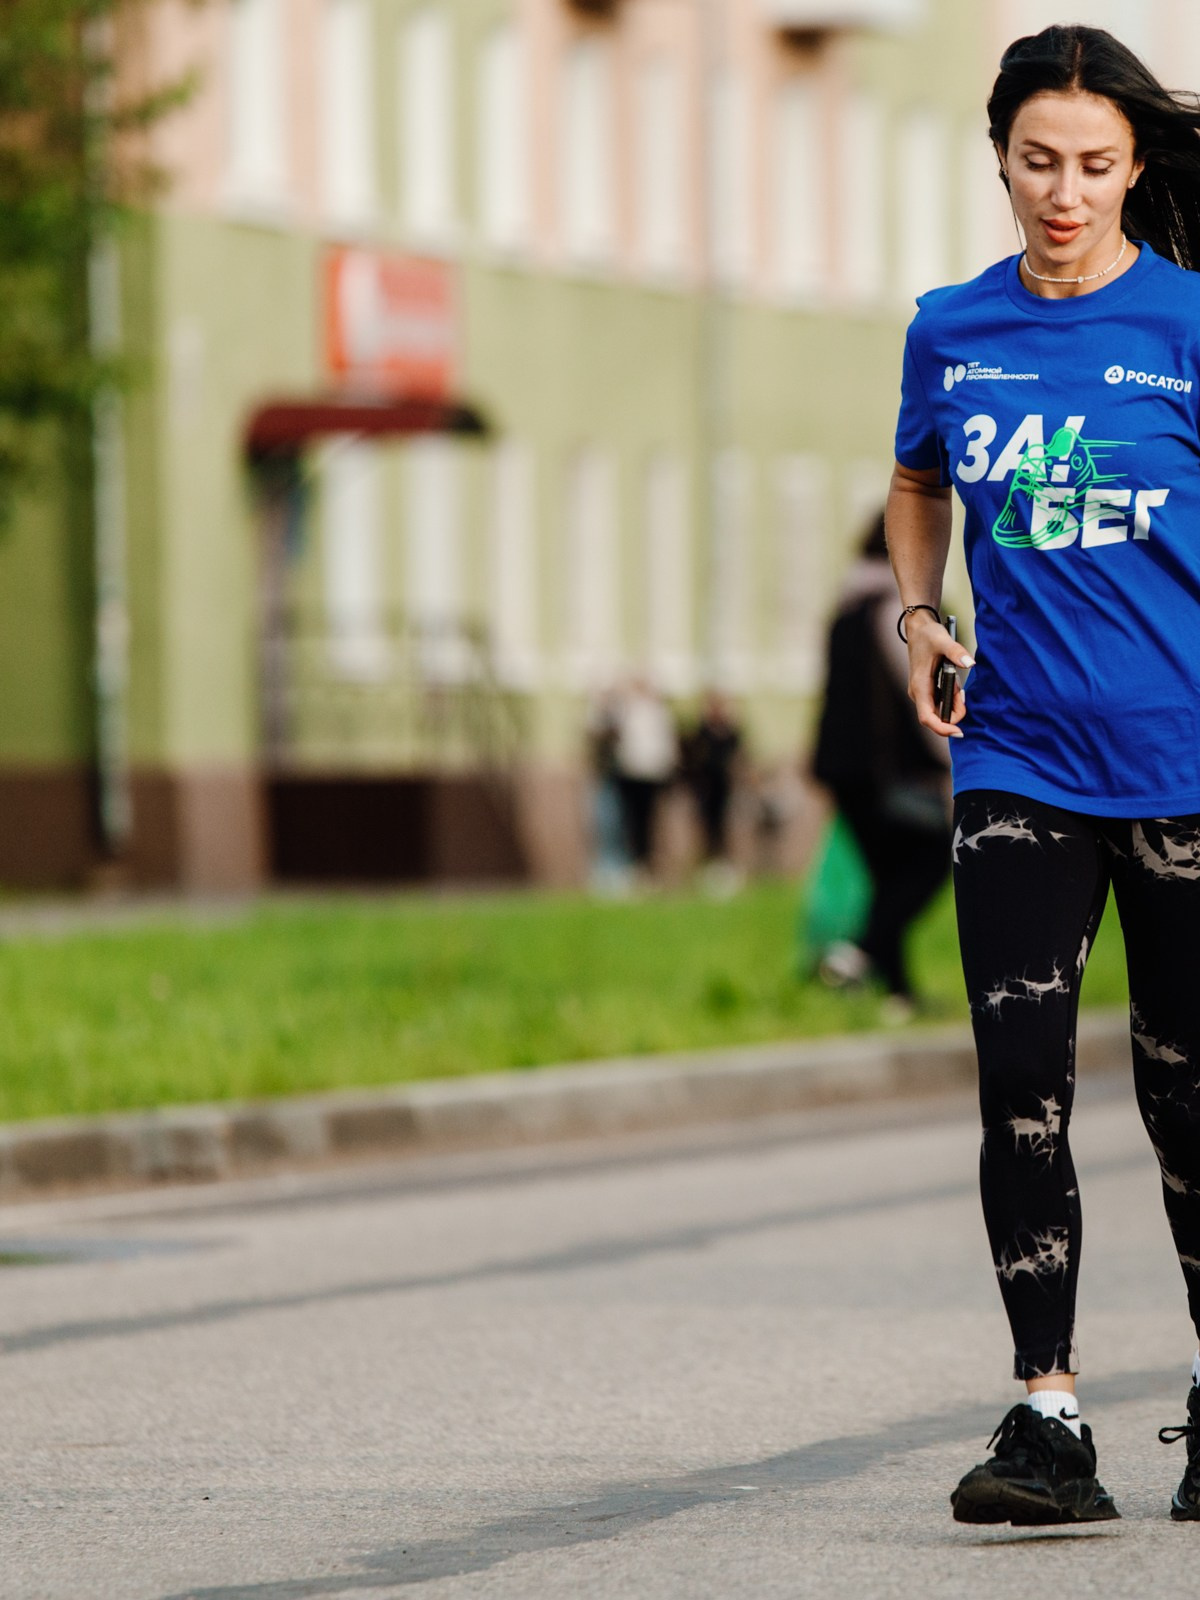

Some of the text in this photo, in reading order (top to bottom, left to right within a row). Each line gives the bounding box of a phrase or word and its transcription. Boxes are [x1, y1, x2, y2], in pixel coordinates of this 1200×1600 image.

[965, 373, 1040, 381] ПРОМЫШЛЕННОСТИ
[967, 366, 1003, 375] АТОМНОЙ
[956, 414, 1086, 483] ЗА!
[1030, 487, 1170, 551] БЕГ
